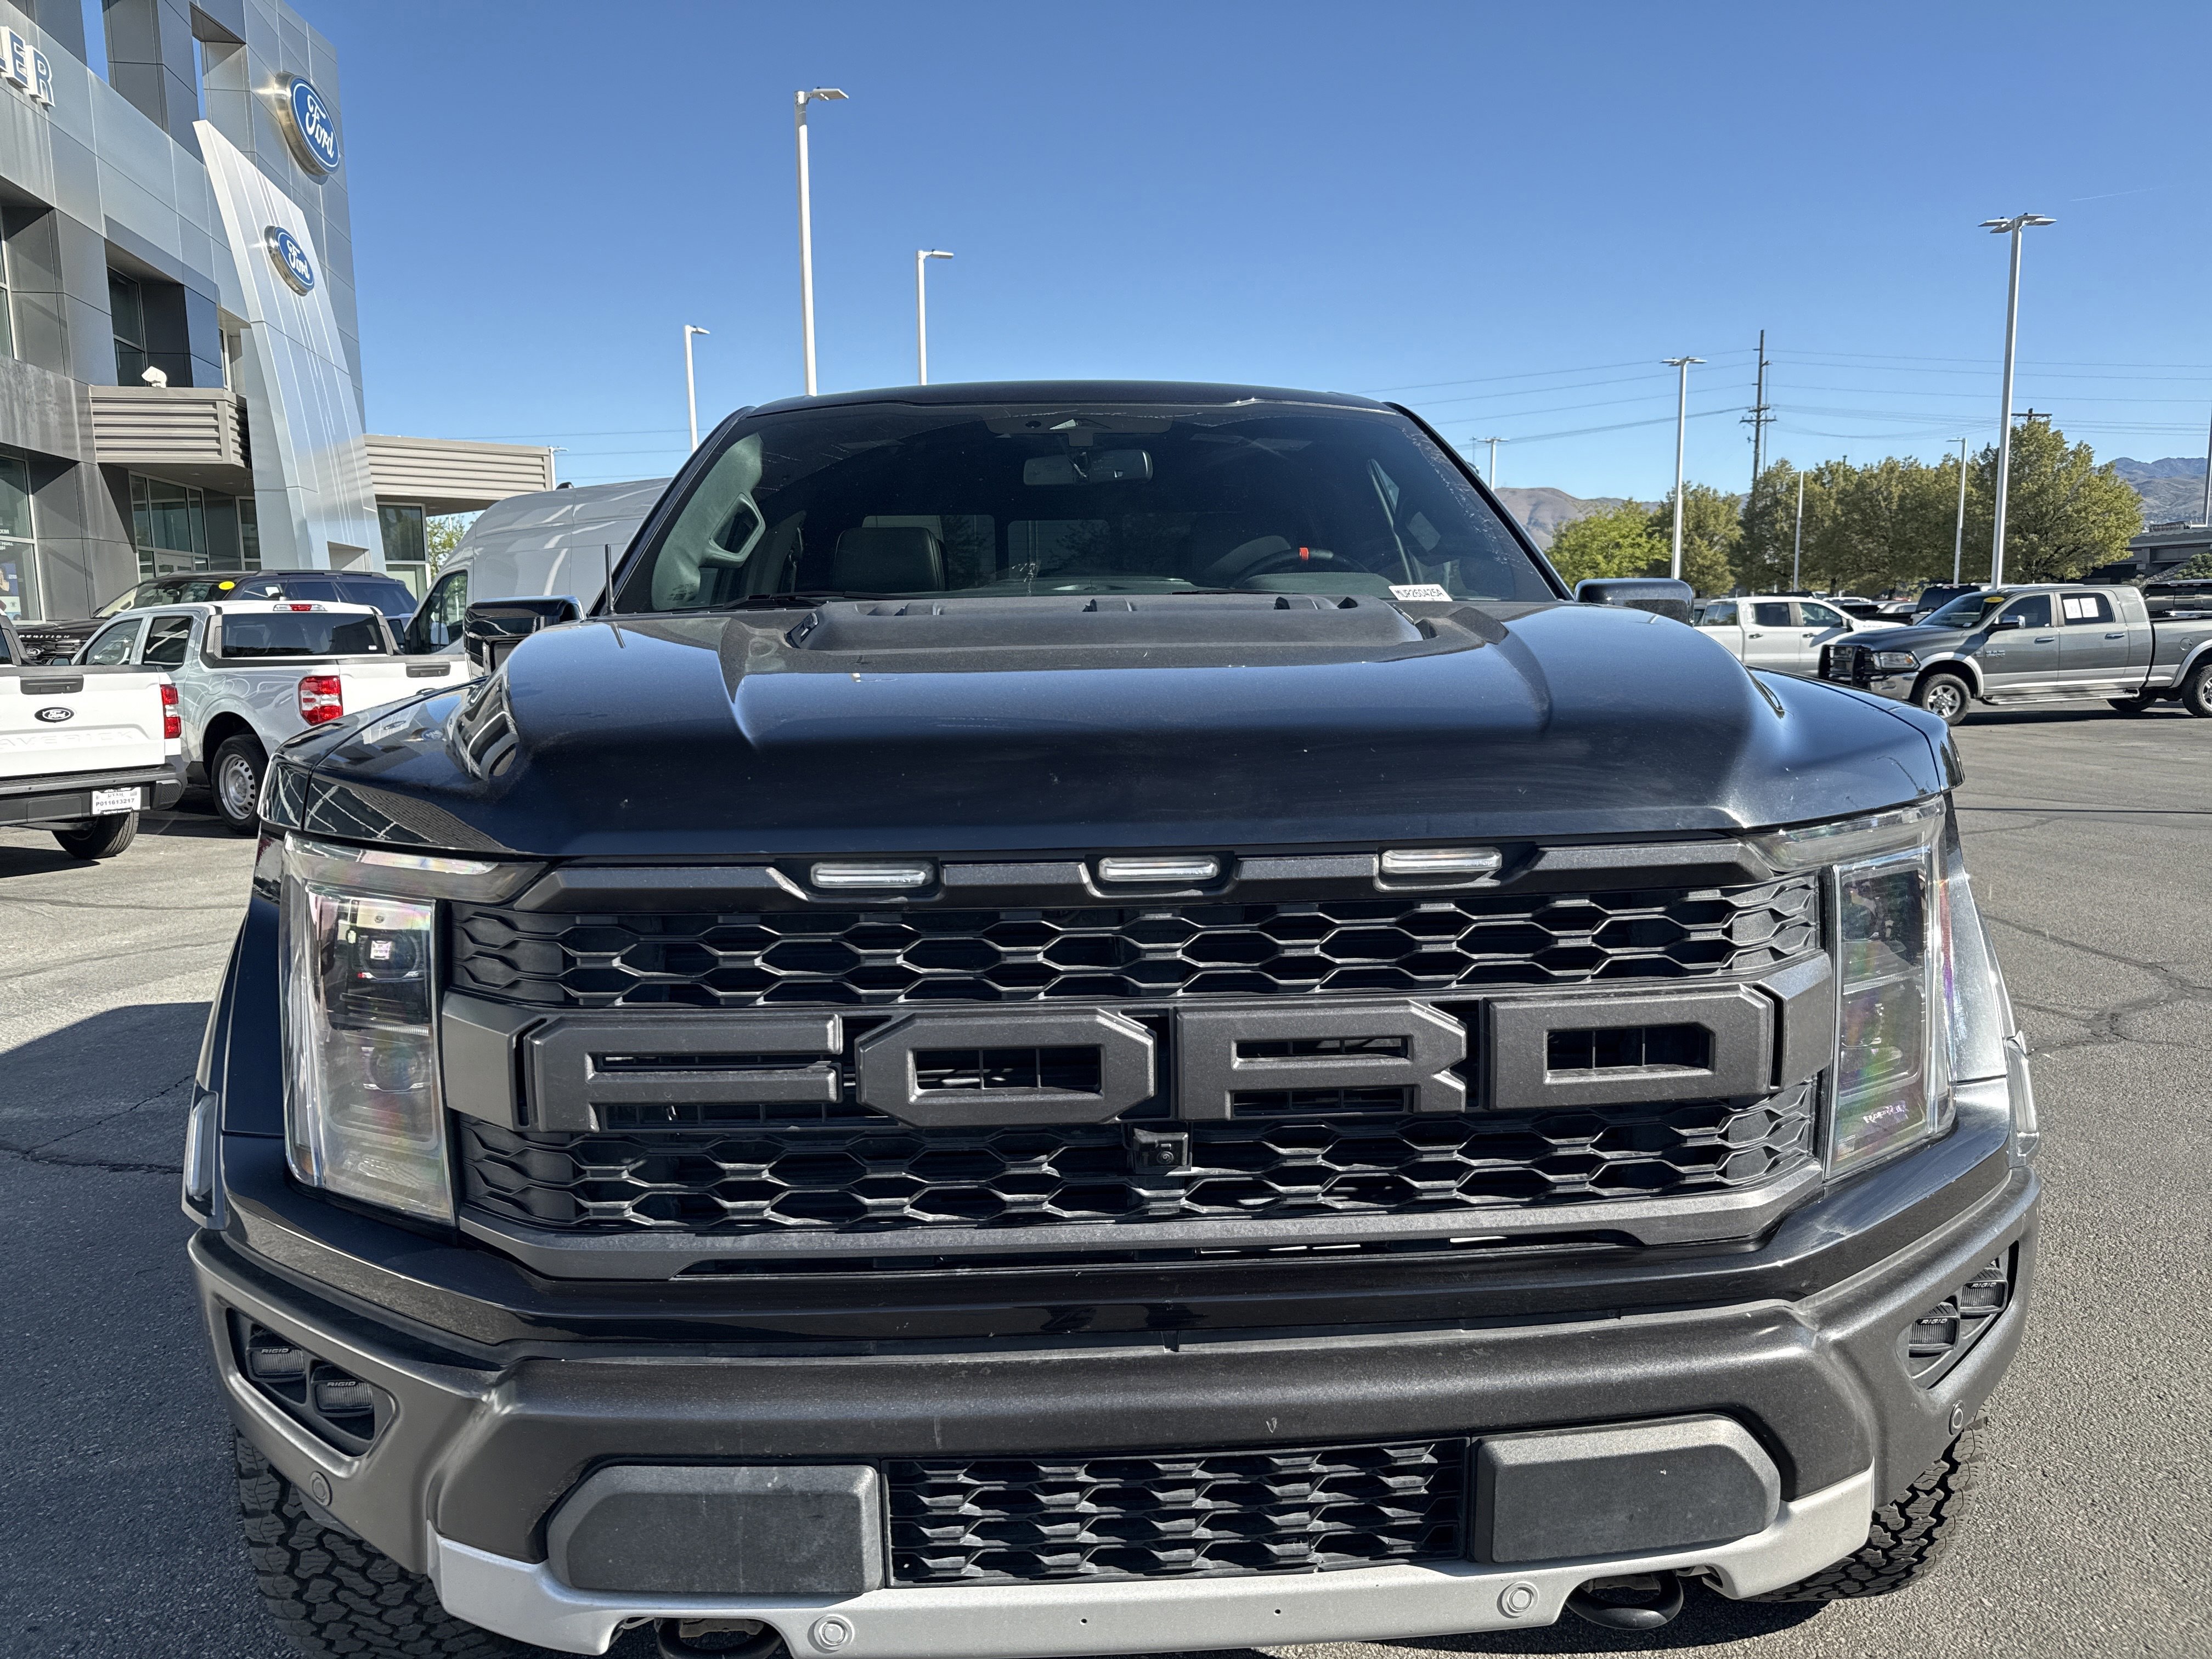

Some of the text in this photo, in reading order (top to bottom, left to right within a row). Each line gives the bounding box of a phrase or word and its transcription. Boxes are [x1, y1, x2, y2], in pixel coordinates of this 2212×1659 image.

[0, 26, 55, 107] ER
[305, 94, 335, 159] Ford
[286, 240, 310, 280] Ford
[524, 983, 1774, 1132] FORD
